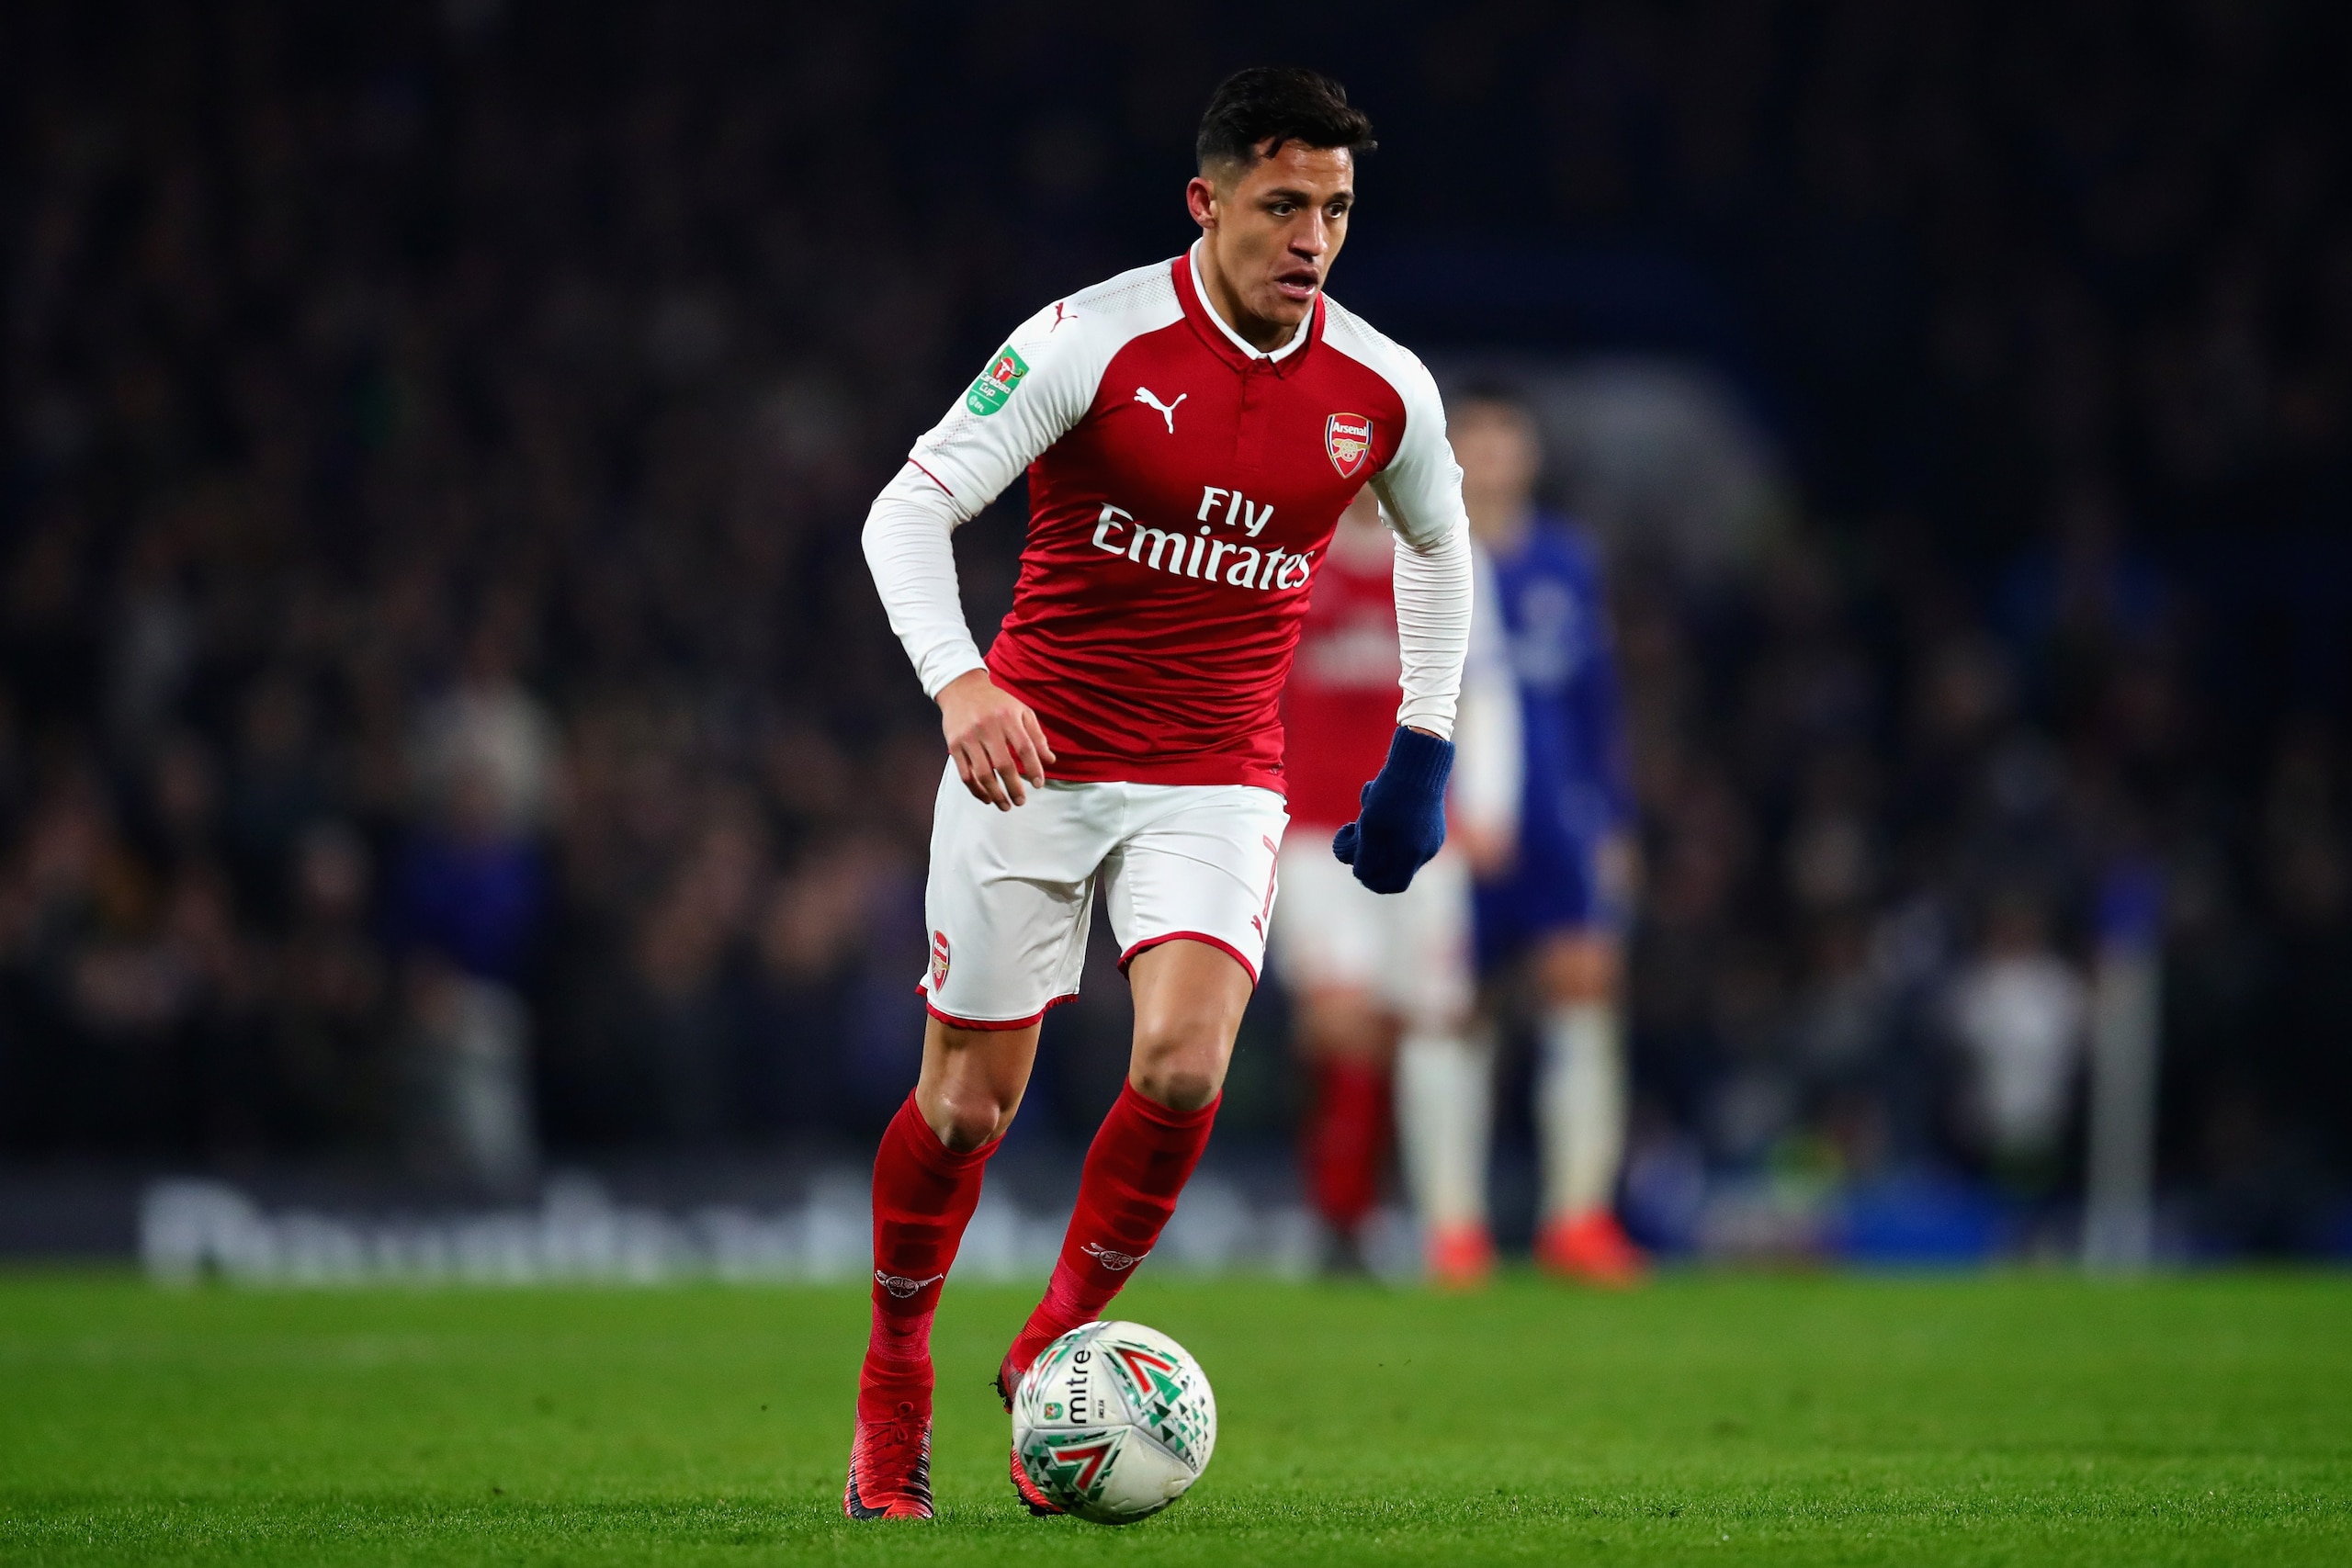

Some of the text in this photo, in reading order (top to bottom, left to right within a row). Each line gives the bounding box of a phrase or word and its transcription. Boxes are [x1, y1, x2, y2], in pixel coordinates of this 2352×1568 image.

[978, 382, 996, 397] Cup
[979, 371, 1012, 395] Carabao
[1332, 422, 1367, 436] Arsenal
[1197, 485, 1274, 538] Fly
[1091, 502, 1315, 591] Emirates
[1066, 1350, 1091, 1424] mitre
